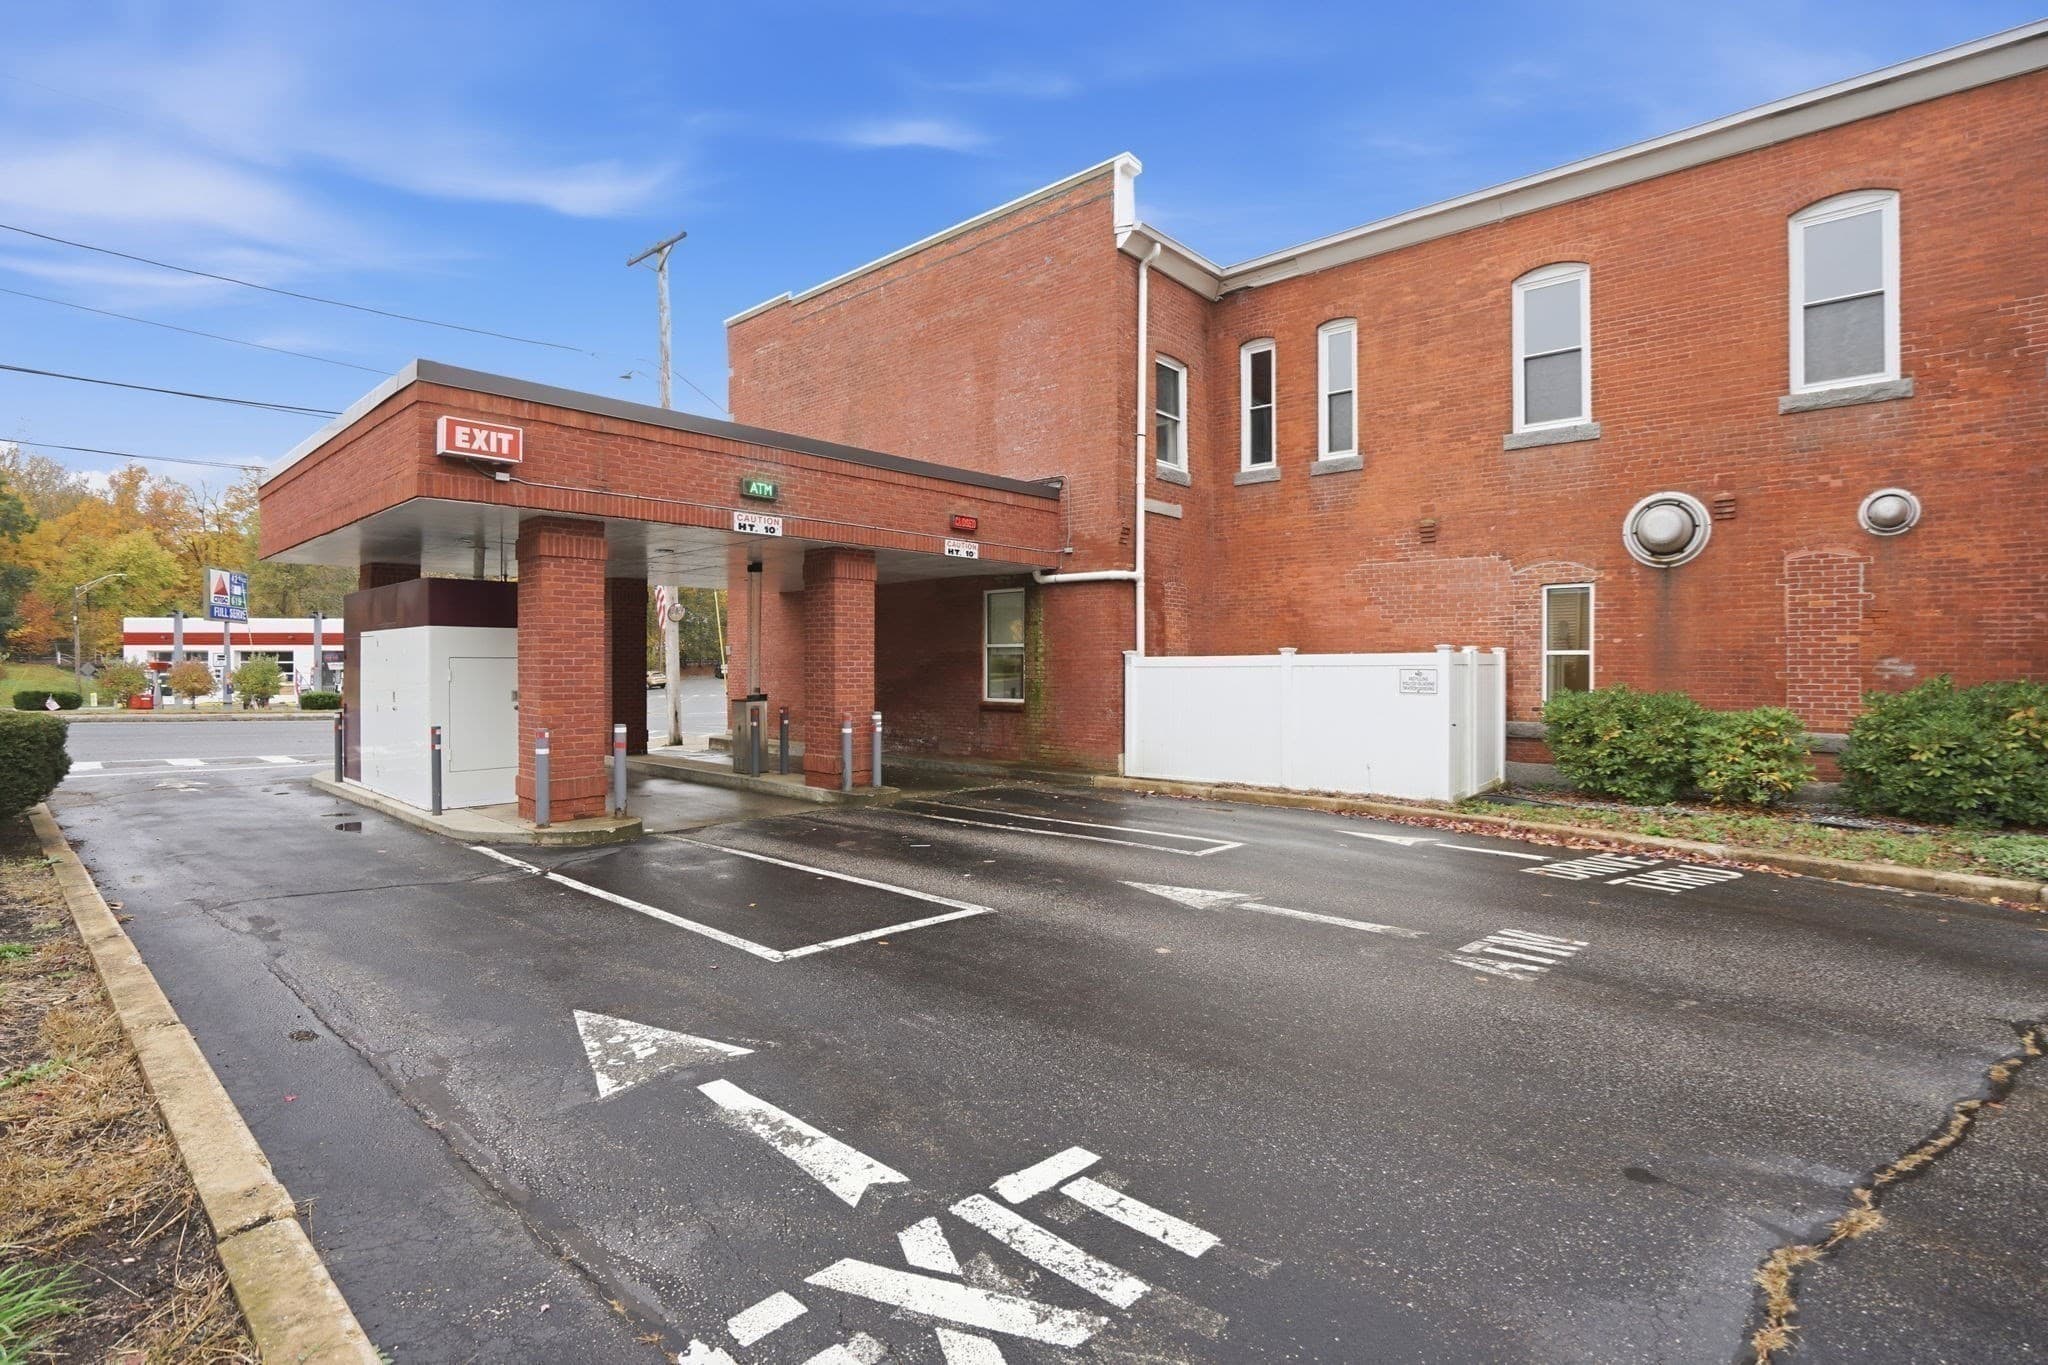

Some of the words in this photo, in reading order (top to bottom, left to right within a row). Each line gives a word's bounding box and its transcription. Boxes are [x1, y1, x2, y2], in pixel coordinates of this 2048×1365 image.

[455, 425, 513, 454] EXIT
[749, 482, 773, 496] ATM
[736, 513, 780, 525] CAUTION
[946, 540, 977, 550] CAUTION
[214, 607, 229, 617] FULL
[1519, 852, 1665, 881] DRIVE
[1603, 864, 1744, 893] THRU
